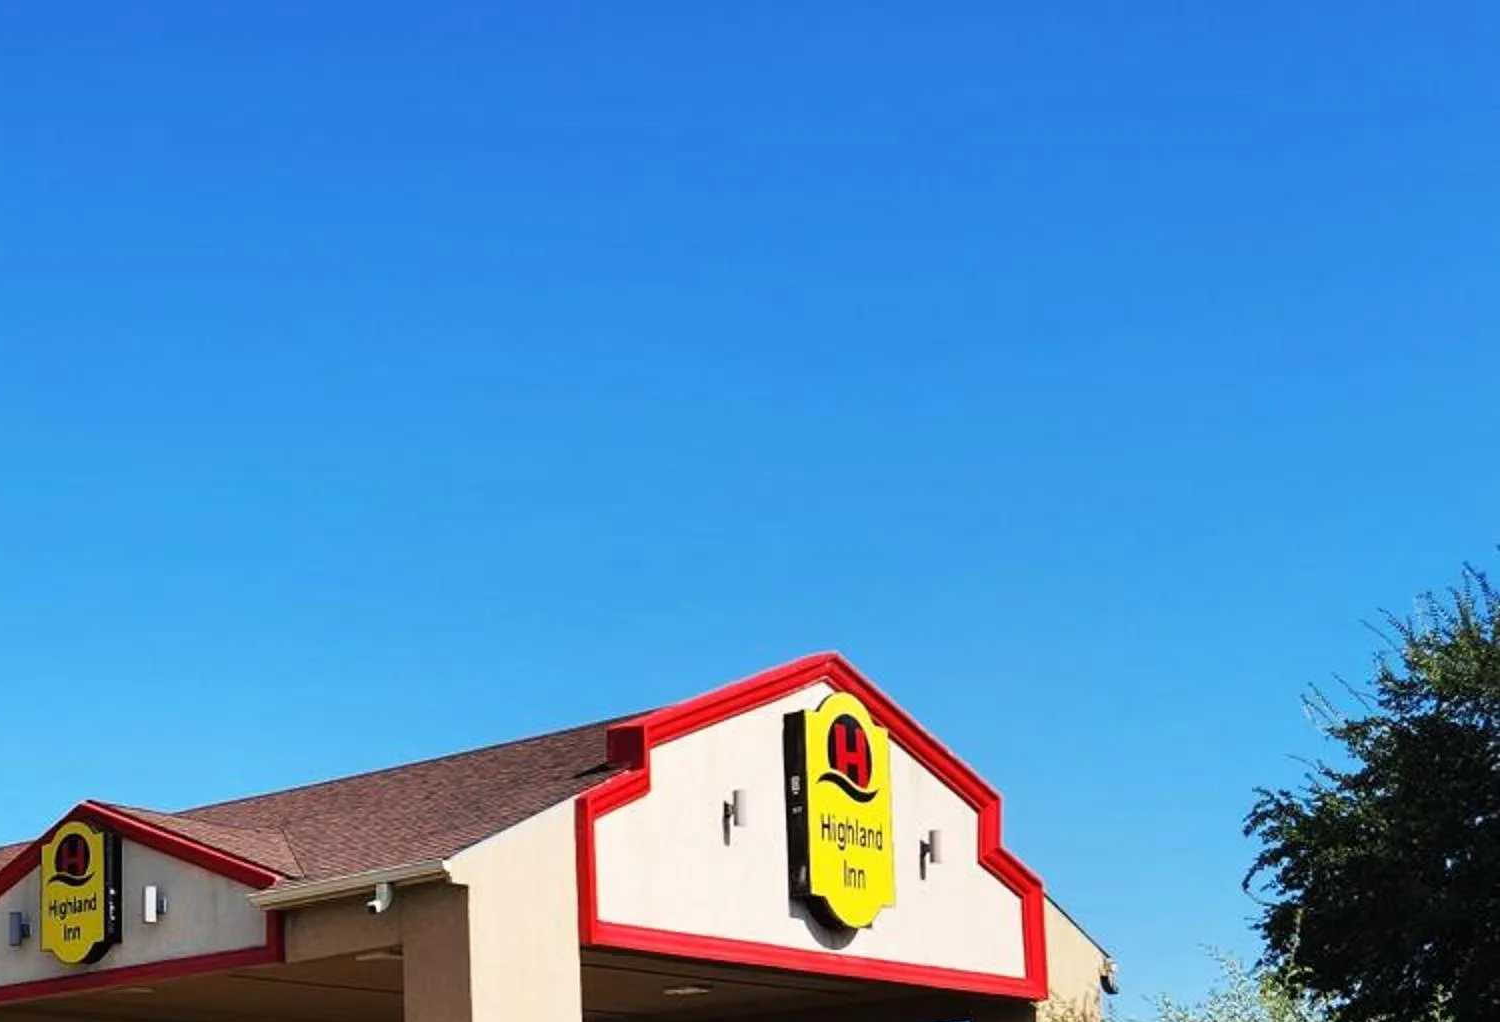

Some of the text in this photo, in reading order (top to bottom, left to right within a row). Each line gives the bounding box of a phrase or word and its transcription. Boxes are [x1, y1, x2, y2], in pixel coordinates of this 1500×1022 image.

[834, 723, 868, 790] H
[820, 813, 883, 851] Highland
[843, 860, 866, 889] Inn
[48, 892, 97, 920] Highland
[63, 924, 81, 942] Inn
